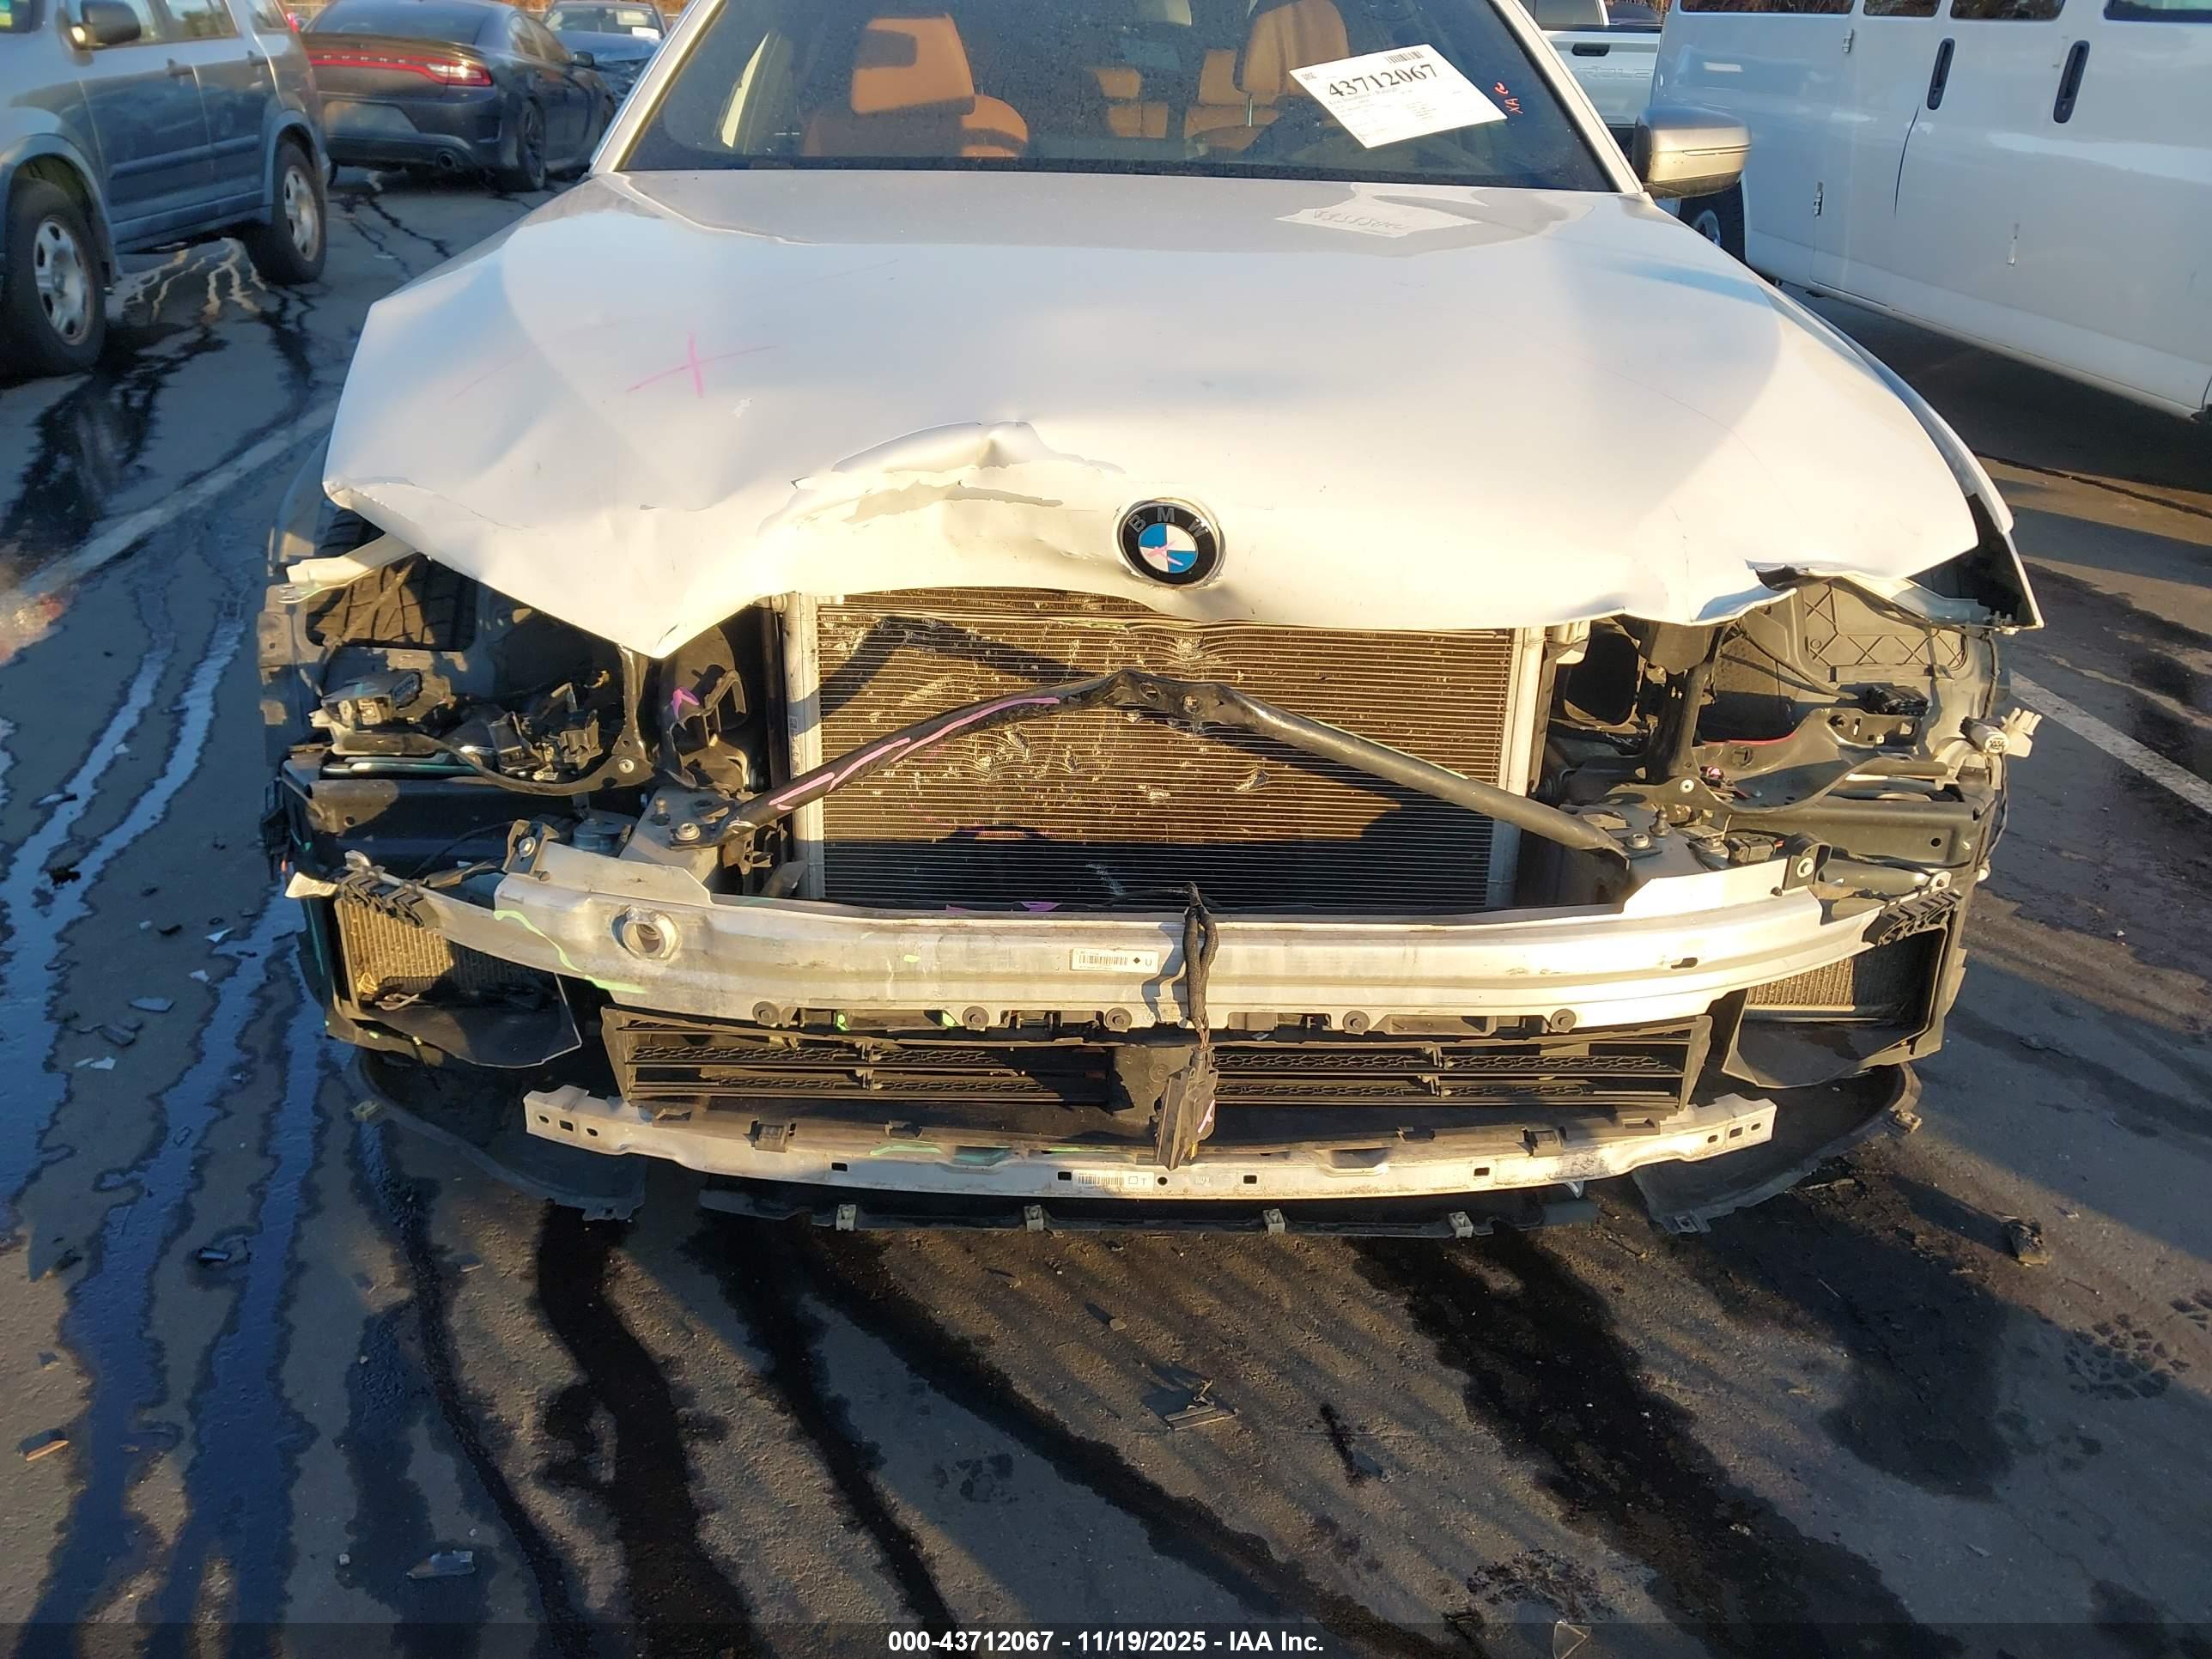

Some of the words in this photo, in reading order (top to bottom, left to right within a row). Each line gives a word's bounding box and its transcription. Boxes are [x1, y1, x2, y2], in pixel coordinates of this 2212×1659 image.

[1329, 63, 1438, 97] 43712067
[1127, 507, 1209, 538] BMW
[1141, 1177, 1147, 1186] T
